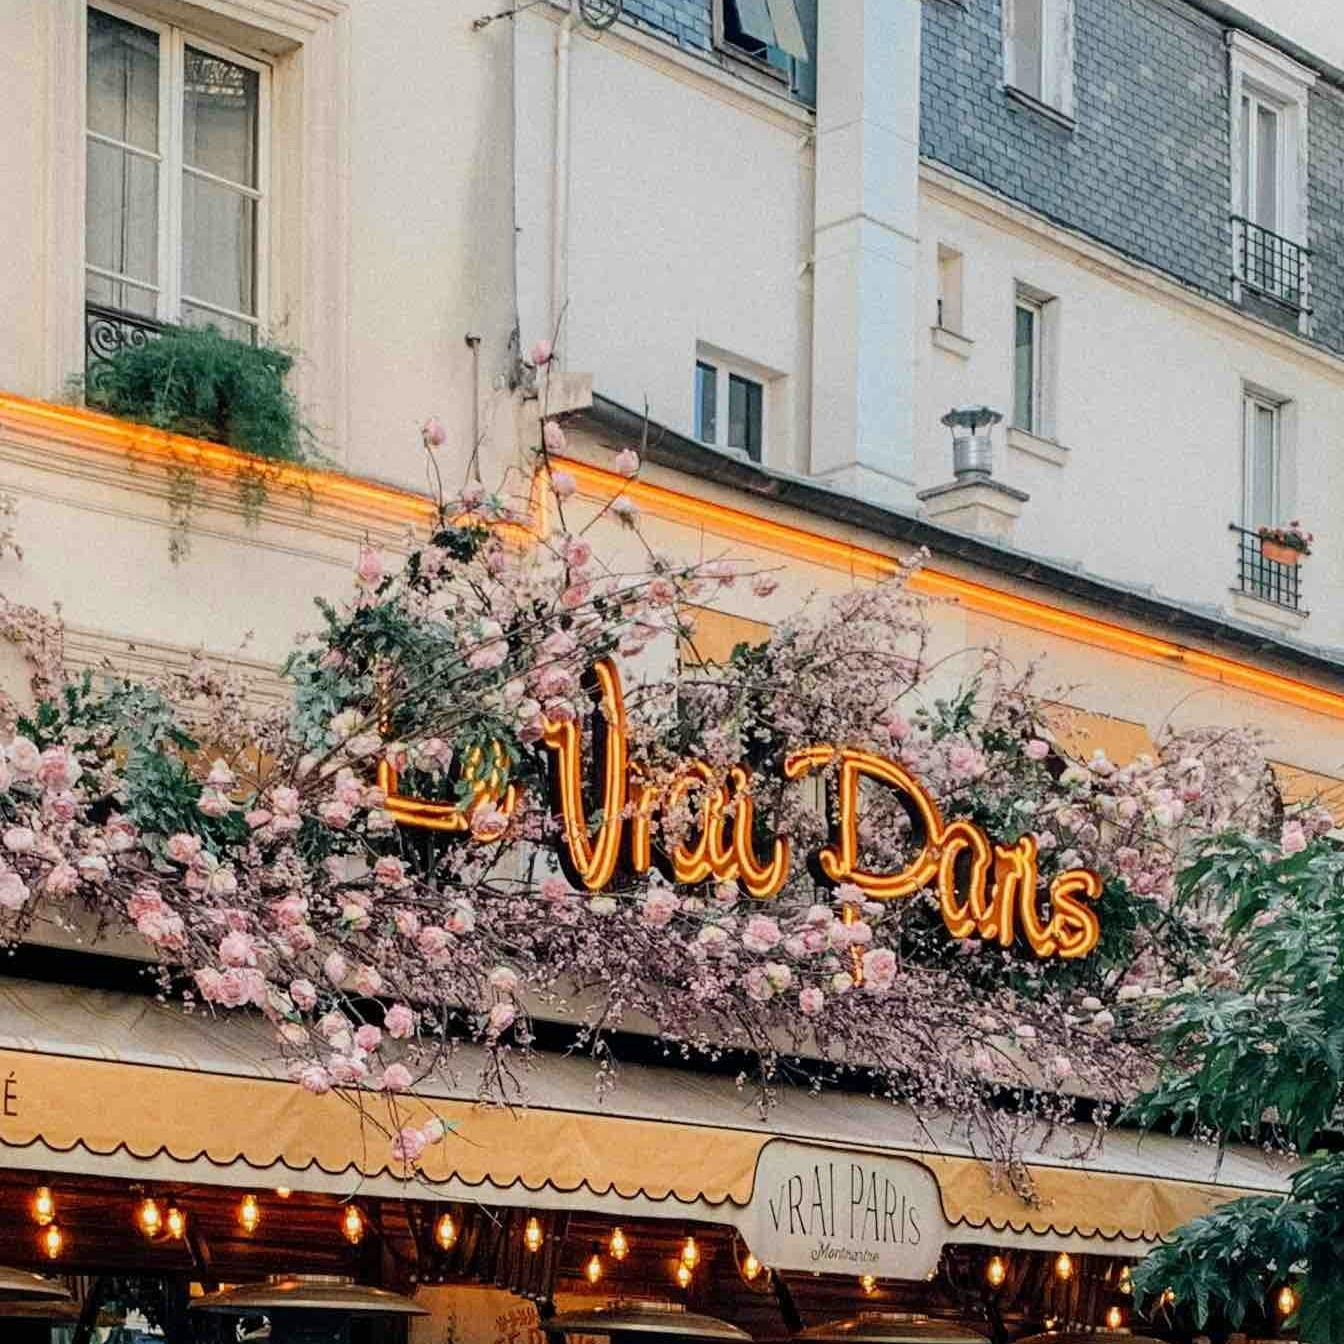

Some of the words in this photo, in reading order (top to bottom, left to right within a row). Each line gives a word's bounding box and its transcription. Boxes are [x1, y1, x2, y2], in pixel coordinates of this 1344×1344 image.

[541, 656, 790, 898] Vrai
[768, 1162, 836, 1237] VRAI
[849, 1162, 922, 1246] PARIS
